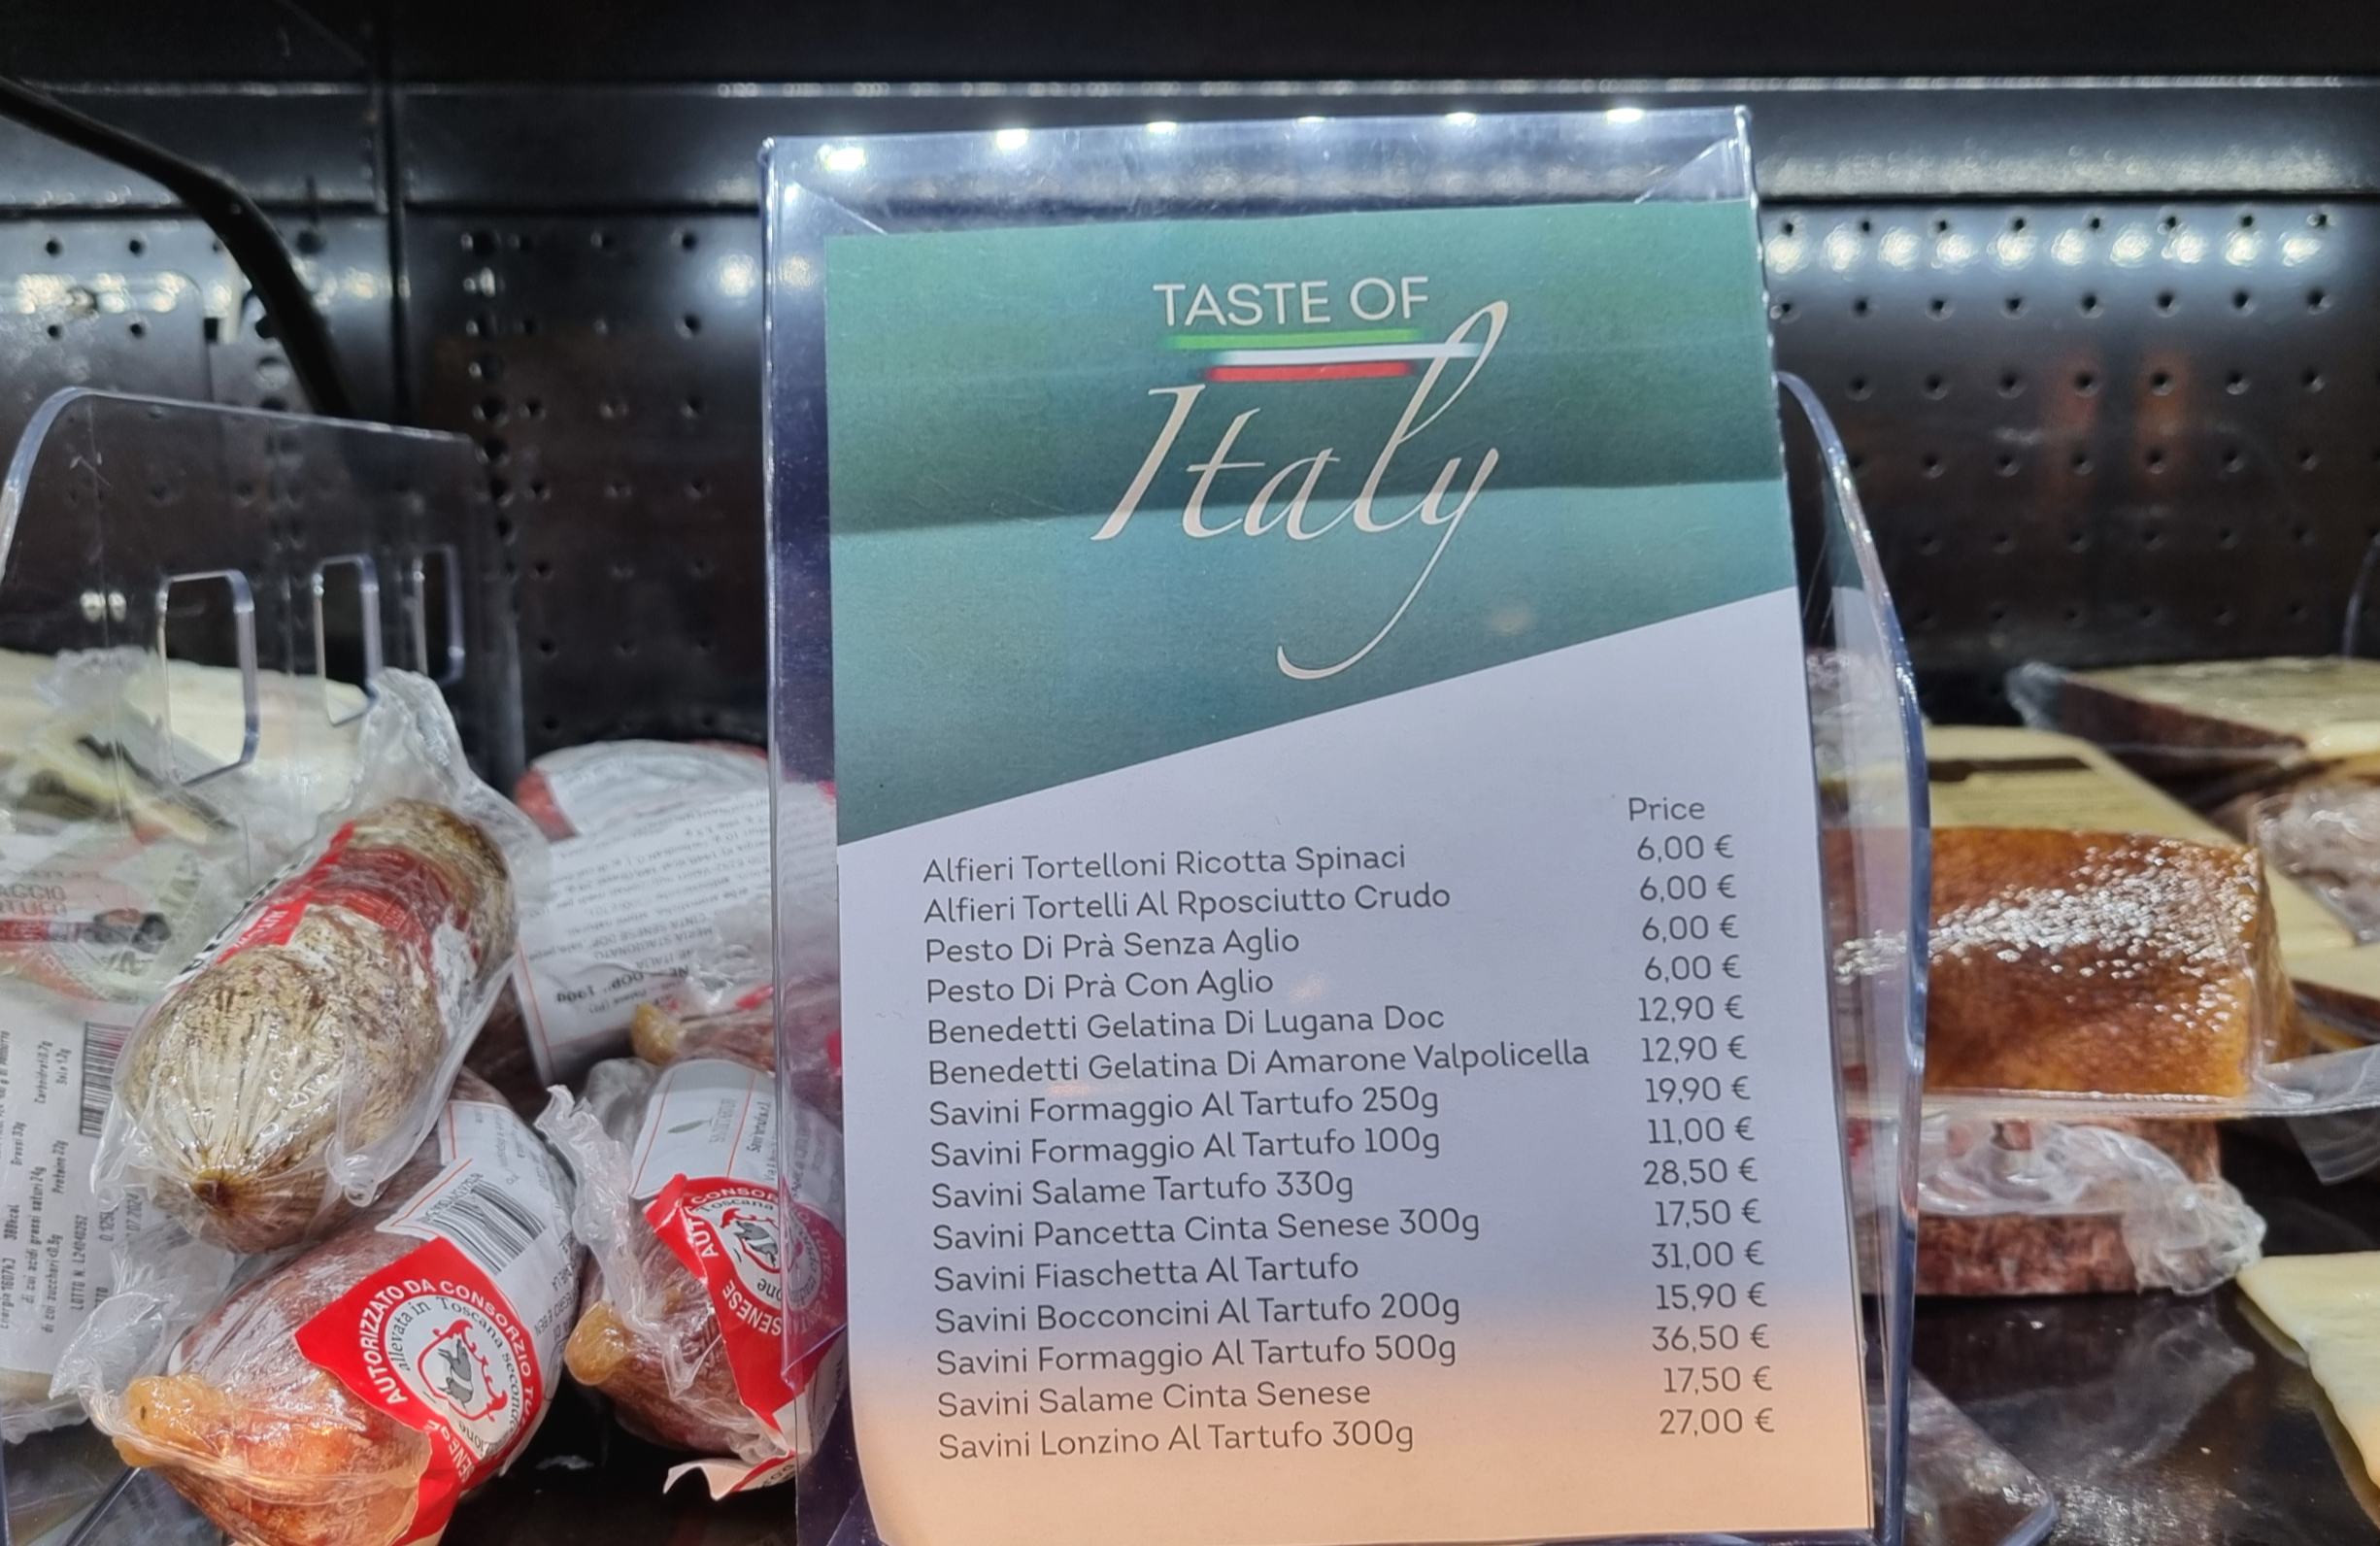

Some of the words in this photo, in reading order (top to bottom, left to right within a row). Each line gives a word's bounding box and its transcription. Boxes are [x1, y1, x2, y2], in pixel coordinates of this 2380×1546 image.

[1153, 280, 1331, 328] TASTE
[1349, 276, 1430, 322] OF
[1089, 299, 1510, 681] Italy
[1627, 796, 1705, 822] Price
[922, 856, 1014, 884] Alfieri
[1021, 851, 1166, 880] Tortelloni
[1176, 850, 1287, 876] Ricotta
[1295, 843, 1405, 879] Spinaci
[1636, 834, 1705, 863] 6,00
[1714, 833, 1734, 859] €
[923, 895, 1015, 924] Alfieri
[1022, 891, 1128, 921] Tortelli
[1135, 889, 1169, 917] Al
[1177, 888, 1346, 923] Rposciutto
[1354, 881, 1451, 910] Crudo
[1639, 874, 1707, 903] 6,00
[1716, 873, 1737, 899] €
[925, 938, 1014, 964] Pesto
[1022, 934, 1053, 960] Di
[1063, 932, 1115, 959] Prà
[1123, 931, 1216, 958] Senza
[1222, 926, 1300, 961] Aglio
[1641, 915, 1709, 944] 6,00
[1719, 914, 1739, 939] €
[926, 978, 1015, 1004] Pesto
[1024, 975, 1054, 1001] Di
[1064, 972, 1117, 999] Prà
[1124, 971, 1189, 997] Con
[1195, 967, 1274, 1002] Aglio
[1644, 955, 1712, 984] 6,00
[1721, 954, 1742, 980] €
[928, 1014, 1077, 1045] Benedetti
[1087, 1011, 1216, 1039] Gelatina
[1224, 1009, 1254, 1035] Di
[1264, 1008, 1375, 1041] Lugana
[1384, 1004, 1445, 1030] Doc
[1637, 994, 1715, 1025] 12,90
[1724, 993, 1745, 1021] €
[928, 1055, 1079, 1086] Benedetti
[1088, 1052, 1219, 1080] Gelatina
[1226, 1050, 1256, 1076] Di
[1264, 1048, 1407, 1075] Amarone
[1413, 1038, 1591, 1077] Valpolicella
[1641, 1035, 1718, 1064] 12,90
[1726, 1034, 1748, 1060] €
[929, 1098, 1020, 1126] Savini
[1030, 1092, 1193, 1128] Formaggio
[1200, 1090, 1235, 1118] Al
[1239, 1087, 1354, 1116] Tartufo
[1362, 1085, 1439, 1119] 250g
[1645, 1076, 1722, 1105] 19,90
[1730, 1075, 1752, 1101] €
[930, 1139, 1021, 1168] Savini
[1031, 1134, 1195, 1169] Formaggio
[1202, 1130, 1236, 1159] Al
[1241, 1127, 1356, 1158] Tartufo
[1364, 1126, 1440, 1160] 100g
[1647, 1116, 1726, 1146] 11,00
[1733, 1115, 1756, 1142] €
[931, 1181, 1022, 1209] Savini
[1031, 1177, 1146, 1205] Salame
[1152, 1171, 1267, 1201] Tartufo
[1276, 1169, 1354, 1204] 330g
[1642, 1158, 1728, 1188] 28,50
[1737, 1157, 1759, 1183] €
[29, 1182, 44, 1212] saturi
[1655, 1198, 1731, 1229] 17,50
[1740, 1197, 1761, 1225] €
[28, 1215, 42, 1245] grassi
[932, 1222, 1023, 1251] Savini
[1034, 1219, 1176, 1248] Pancetta
[1184, 1215, 1269, 1242] Cinta
[1277, 1212, 1390, 1239] Senese
[1399, 1207, 1480, 1241] 300g
[934, 1263, 1024, 1293] Savini
[1035, 1259, 1198, 1290] Fiaschetta
[1205, 1255, 1240, 1284] Al
[1244, 1252, 1359, 1282] Tartufo
[1651, 1240, 1734, 1271] 31,00
[1744, 1239, 1765, 1266] €
[46, 1260, 59, 1301] zuccheri
[70, 1280, 86, 1311] LOTTO
[1656, 1282, 1737, 1312] 15,90
[1746, 1281, 1768, 1308] €
[721, 1278, 783, 1336] SENESE
[935, 1305, 1026, 1334] Savini
[1037, 1298, 1209, 1331] Bocconcini
[1216, 1296, 1252, 1325] Al
[1256, 1293, 1371, 1324] Tartufo
[1380, 1292, 1460, 1326] 200g
[359, 1284, 409, 1405] AUTORIZZATO
[402, 1278, 437, 1295] DA
[439, 1280, 532, 1378] CONSORZIO
[389, 1313, 414, 1373] allevata
[411, 1299, 432, 1317] in
[435, 1295, 505, 1350] Toscana
[1652, 1324, 1739, 1354] 36,50
[1749, 1323, 1770, 1350] €
[936, 1347, 1027, 1376] Savini
[1038, 1341, 1203, 1376] Formaggio
[1211, 1338, 1245, 1366] Al
[1250, 1334, 1366, 1365] Tartufo
[1375, 1333, 1457, 1367] 500g
[1663, 1365, 1741, 1395] 17,50
[1752, 1364, 1773, 1392] €
[938, 1389, 1028, 1418] Savini
[1039, 1385, 1154, 1414] Salame
[1162, 1383, 1248, 1409] Cinta
[1257, 1380, 1371, 1407] Senese
[939, 1430, 1030, 1461] Savini
[1041, 1428, 1159, 1457] Lonzino
[1167, 1423, 1202, 1452] Al
[1207, 1420, 1323, 1450] Tartufo
[1332, 1419, 1414, 1453] 300g
[1659, 1407, 1743, 1437] 27,00
[1754, 1407, 1775, 1433] €
